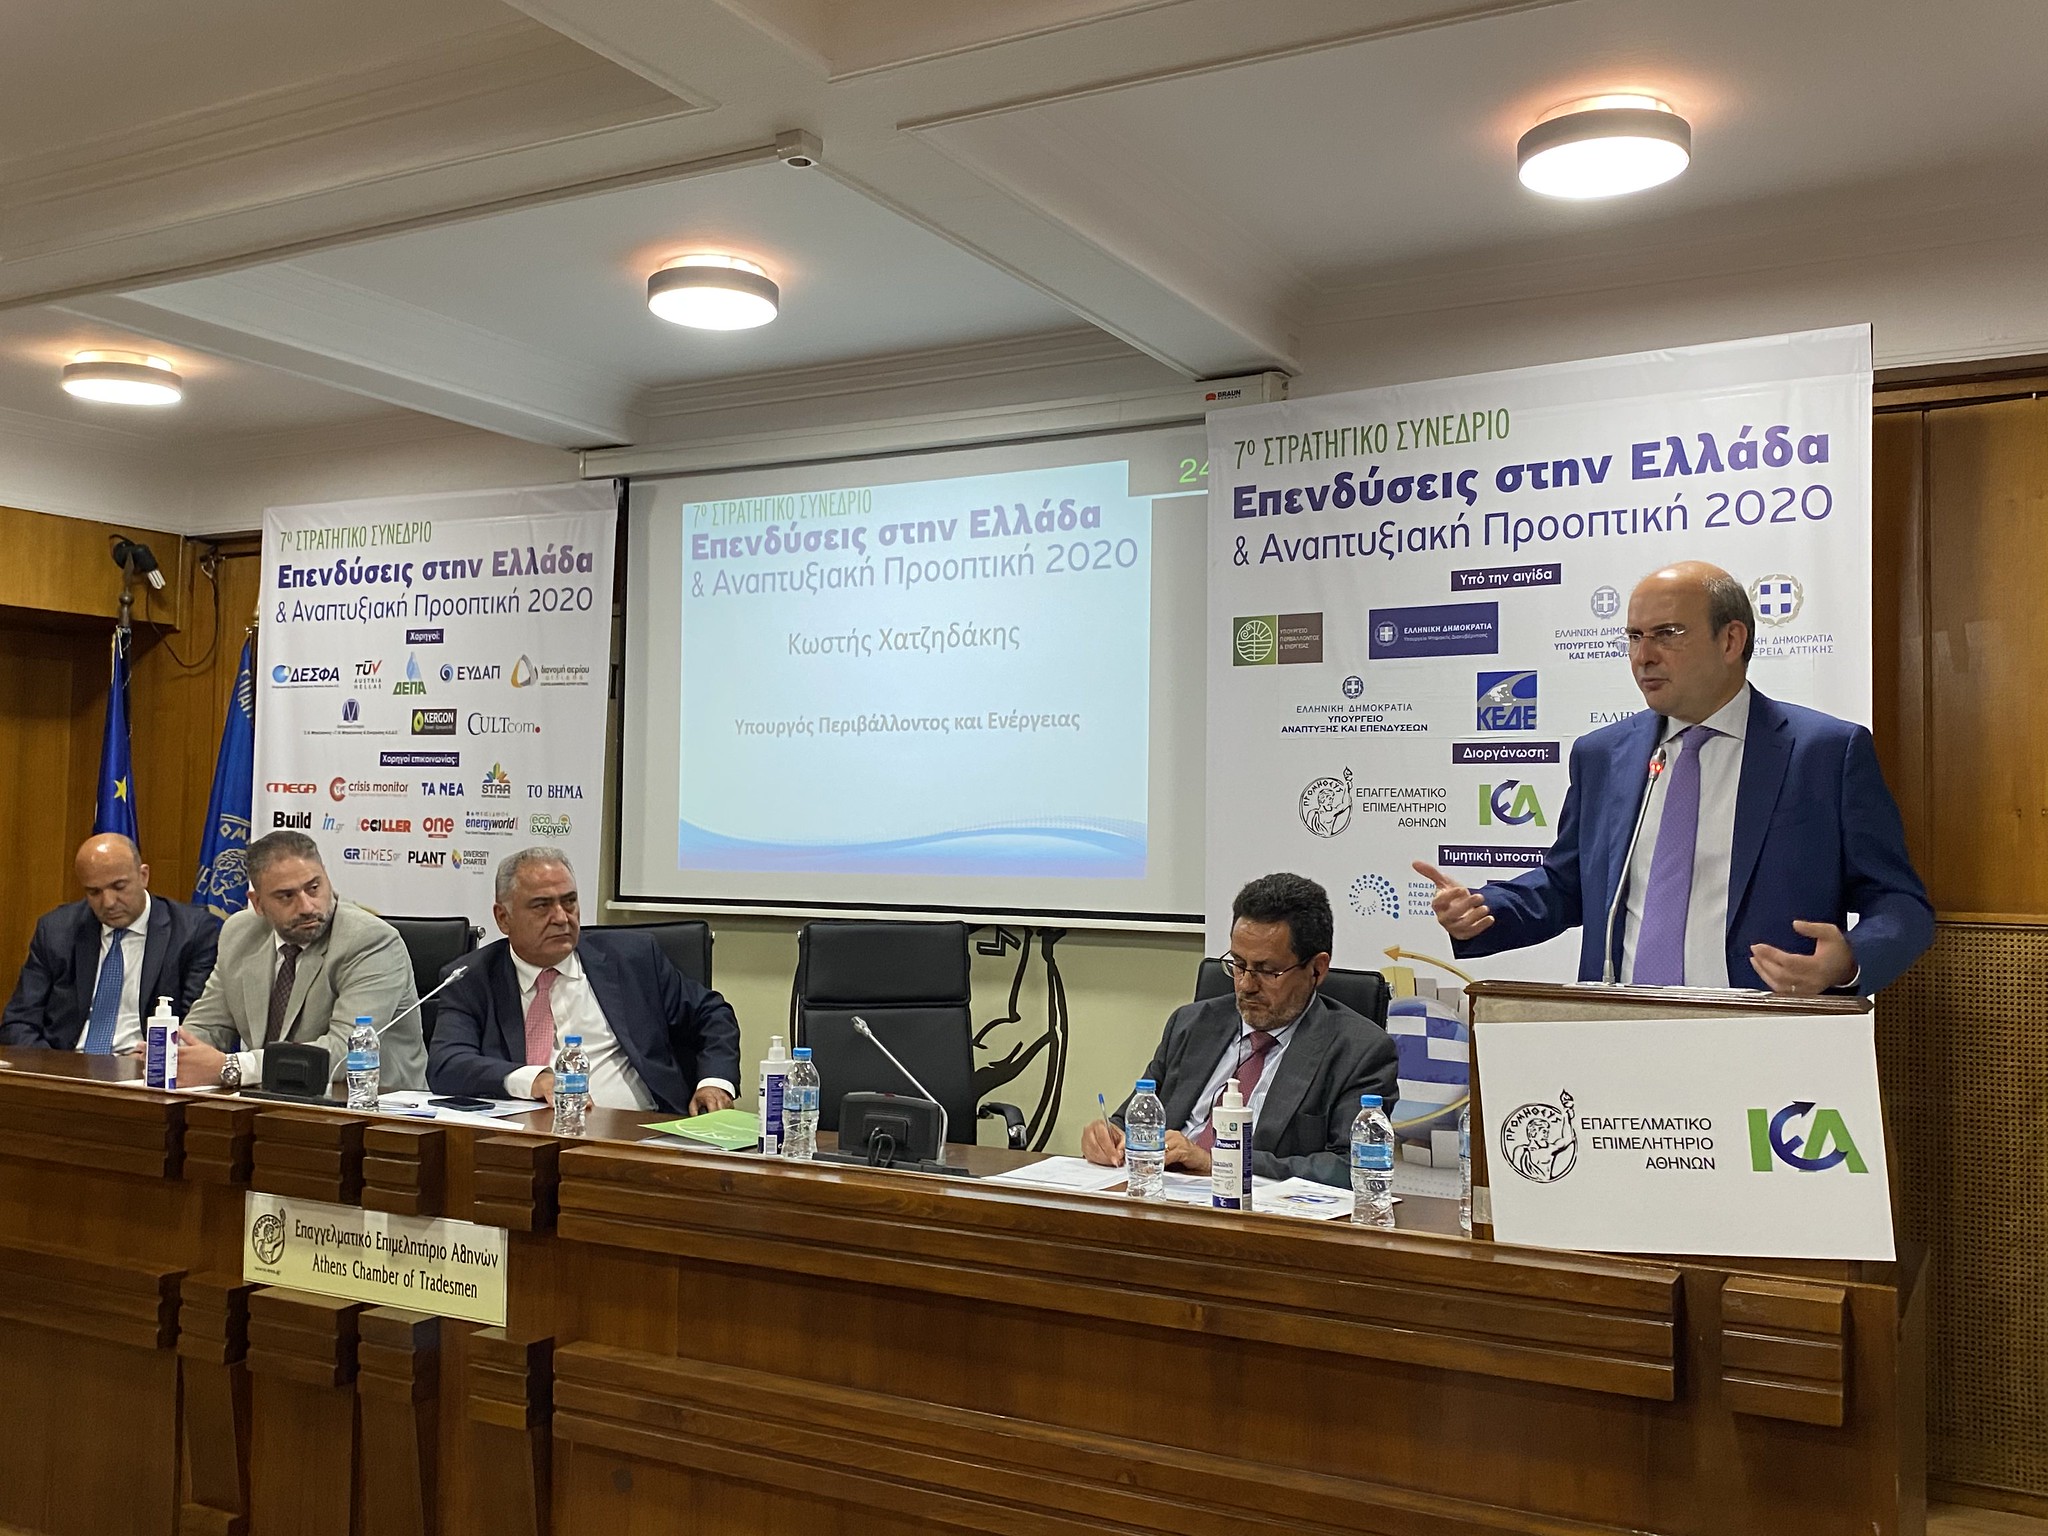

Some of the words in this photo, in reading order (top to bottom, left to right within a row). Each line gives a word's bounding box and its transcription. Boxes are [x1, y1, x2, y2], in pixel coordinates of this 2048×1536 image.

[1217, 389, 1241, 398] BRAUN
[1263, 422, 1388, 467] ΣΤΡΑΤΗΓΙΚΟ
[1396, 407, 1511, 452] ΣΥΝΕΔΡΙΟ
[1233, 465, 1479, 519] Επενδύσεις
[1495, 454, 1613, 494] στην
[1631, 425, 1829, 480] Ελλάδα
[712, 497, 795, 526] ΣΤΡΑΤΗΓΙΚΟ
[799, 489, 872, 521] ΣΥΝΕΔΡΙΟ
[691, 521, 867, 560] Επενδύσεις
[878, 517, 958, 547] στην
[970, 498, 1101, 539] Ελλάδα
[1233, 535, 1250, 567] &
[1259, 512, 1470, 565] Αναπτυξιακή
[1484, 493, 1688, 552] Προοπτική
[1704, 484, 1833, 529] 2020
[296, 525, 367, 551] ΣΤΡΑΤΗΓΙΚΟ
[371, 520, 432, 547] ΣΥΝΕΔΡΙΟ
[277, 556, 414, 589] Επενδύσεις
[422, 557, 484, 582] στην
[492, 544, 594, 577] Ελλάδα
[692, 571, 705, 598] &
[712, 557, 875, 597] Αναπτυξιακή
[885, 545, 1035, 589] Προοπτική
[1046, 537, 1138, 574] 2020
[1460, 569, 1485, 586] Υπό
[1489, 569, 1510, 586] την
[1512, 566, 1553, 584] αιγίδα
[275, 601, 287, 623] &
[292, 592, 407, 624] Αναπτυξιακή
[414, 587, 520, 621] Προοπτική
[527, 586, 594, 613] 2020
[1404, 626, 1441, 635] ΕΛΛΗΝΙΚΗ
[1442, 622, 1493, 632] ΔΗΜΟΚΡΑΤΙΑ
[1555, 628, 1598, 638] ΕΛΛΗΝΙΚΗ
[1600, 626, 1627, 636] ΔΗΜΟ
[788, 624, 872, 657] Κωστής
[878, 621, 1021, 653] Χατζηδάκης
[1554, 641, 1604, 651] ΥΠΟΥΡΓΕΙΟ
[1754, 636, 1767, 645] ΚΗ
[1772, 634, 1834, 645] ΔΗΜΟΚΡΑΤΙΑ
[1569, 652, 1584, 660] ΚΑΙ
[1587, 650, 1628, 659] ΜΕΤΑΦΟ
[1753, 647, 1784, 656] ΕΡΕΙΑ
[1789, 645, 1834, 655] ΑΤΤΙΚΗΣ
[290, 666, 340, 683] ΔΕΣΦΑ
[457, 665, 501, 681] ΕΥΔΑΠ
[392, 681, 427, 696] ΔΕΠΑ
[1296, 705, 1344, 713] ΕΛΛΗΝΙΚΗ
[1348, 703, 1413, 713] ΔΗΜΟΚΡΑΤΙΑ
[424, 712, 454, 723] KERGON
[735, 716, 814, 737] Υπουργός
[818, 713, 949, 735] Περιβάλλοντος
[954, 713, 983, 731] και
[988, 711, 1080, 731] Ενέργειας
[1328, 715, 1384, 723] ΥΠΟΥΡΓΕΙΟ
[1477, 706, 1537, 730] ΚΕΔΕ
[1590, 711, 1636, 723] ΕΛΛΗ
[1281, 725, 1339, 733] ΑΝΑΠΤΥΞΗΣ
[1341, 724, 1358, 733] ΚΑΙ
[1360, 723, 1429, 733] ΕΠΕΝΔΥΣΕΩΝ
[1463, 745, 1550, 762] Διοργάνωση:
[266, 783, 317, 794] MEGA
[348, 780, 371, 792] crisis
[373, 781, 409, 793] monitor
[422, 783, 436, 796] ΤΑ
[439, 783, 465, 797] ΝΕΑ
[481, 783, 511, 795] STAR
[527, 784, 543, 798] ΤΟ
[547, 784, 584, 799] ΒΗΜΑ
[1356, 788, 1447, 798] ΕΠΑΓΓΕΛΜΑΤΙΚΟ
[1362, 802, 1447, 813] ΕΠΙΜΕΛΗΤΗΡΙΟ
[273, 811, 312, 829] Build
[422, 817, 454, 833] one
[465, 817, 515, 831] energyworld
[532, 816, 550, 825] eco
[1397, 817, 1447, 828] ΑΘΗΝΩΝ
[408, 850, 447, 865] PLANT
[463, 850, 490, 859] DIVERSITY
[463, 858, 487, 866] CHARTER
[1443, 848, 1492, 864] Τιμητική
[1495, 850, 1545, 866] υποστή
[1581, 1117, 1712, 1132] ΕΠΑΓΓΕΛΜΑΤΙΚΟ
[1592, 1136, 1714, 1151] ΕΠΙΜΕΛΗΤΗΡΙΟ
[1645, 1156, 1715, 1171] ΑΘΗΝΩΝ
[295, 1218, 371, 1249] Επαγγελματικό
[376, 1231, 447, 1263] Επιμελητήριο
[450, 1242, 498, 1268] Αθηνών
[312, 1252, 347, 1277] Athens
[352, 1260, 399, 1286] Chamber
[403, 1268, 415, 1288] of
[419, 1270, 478, 1299] Tradesmen
